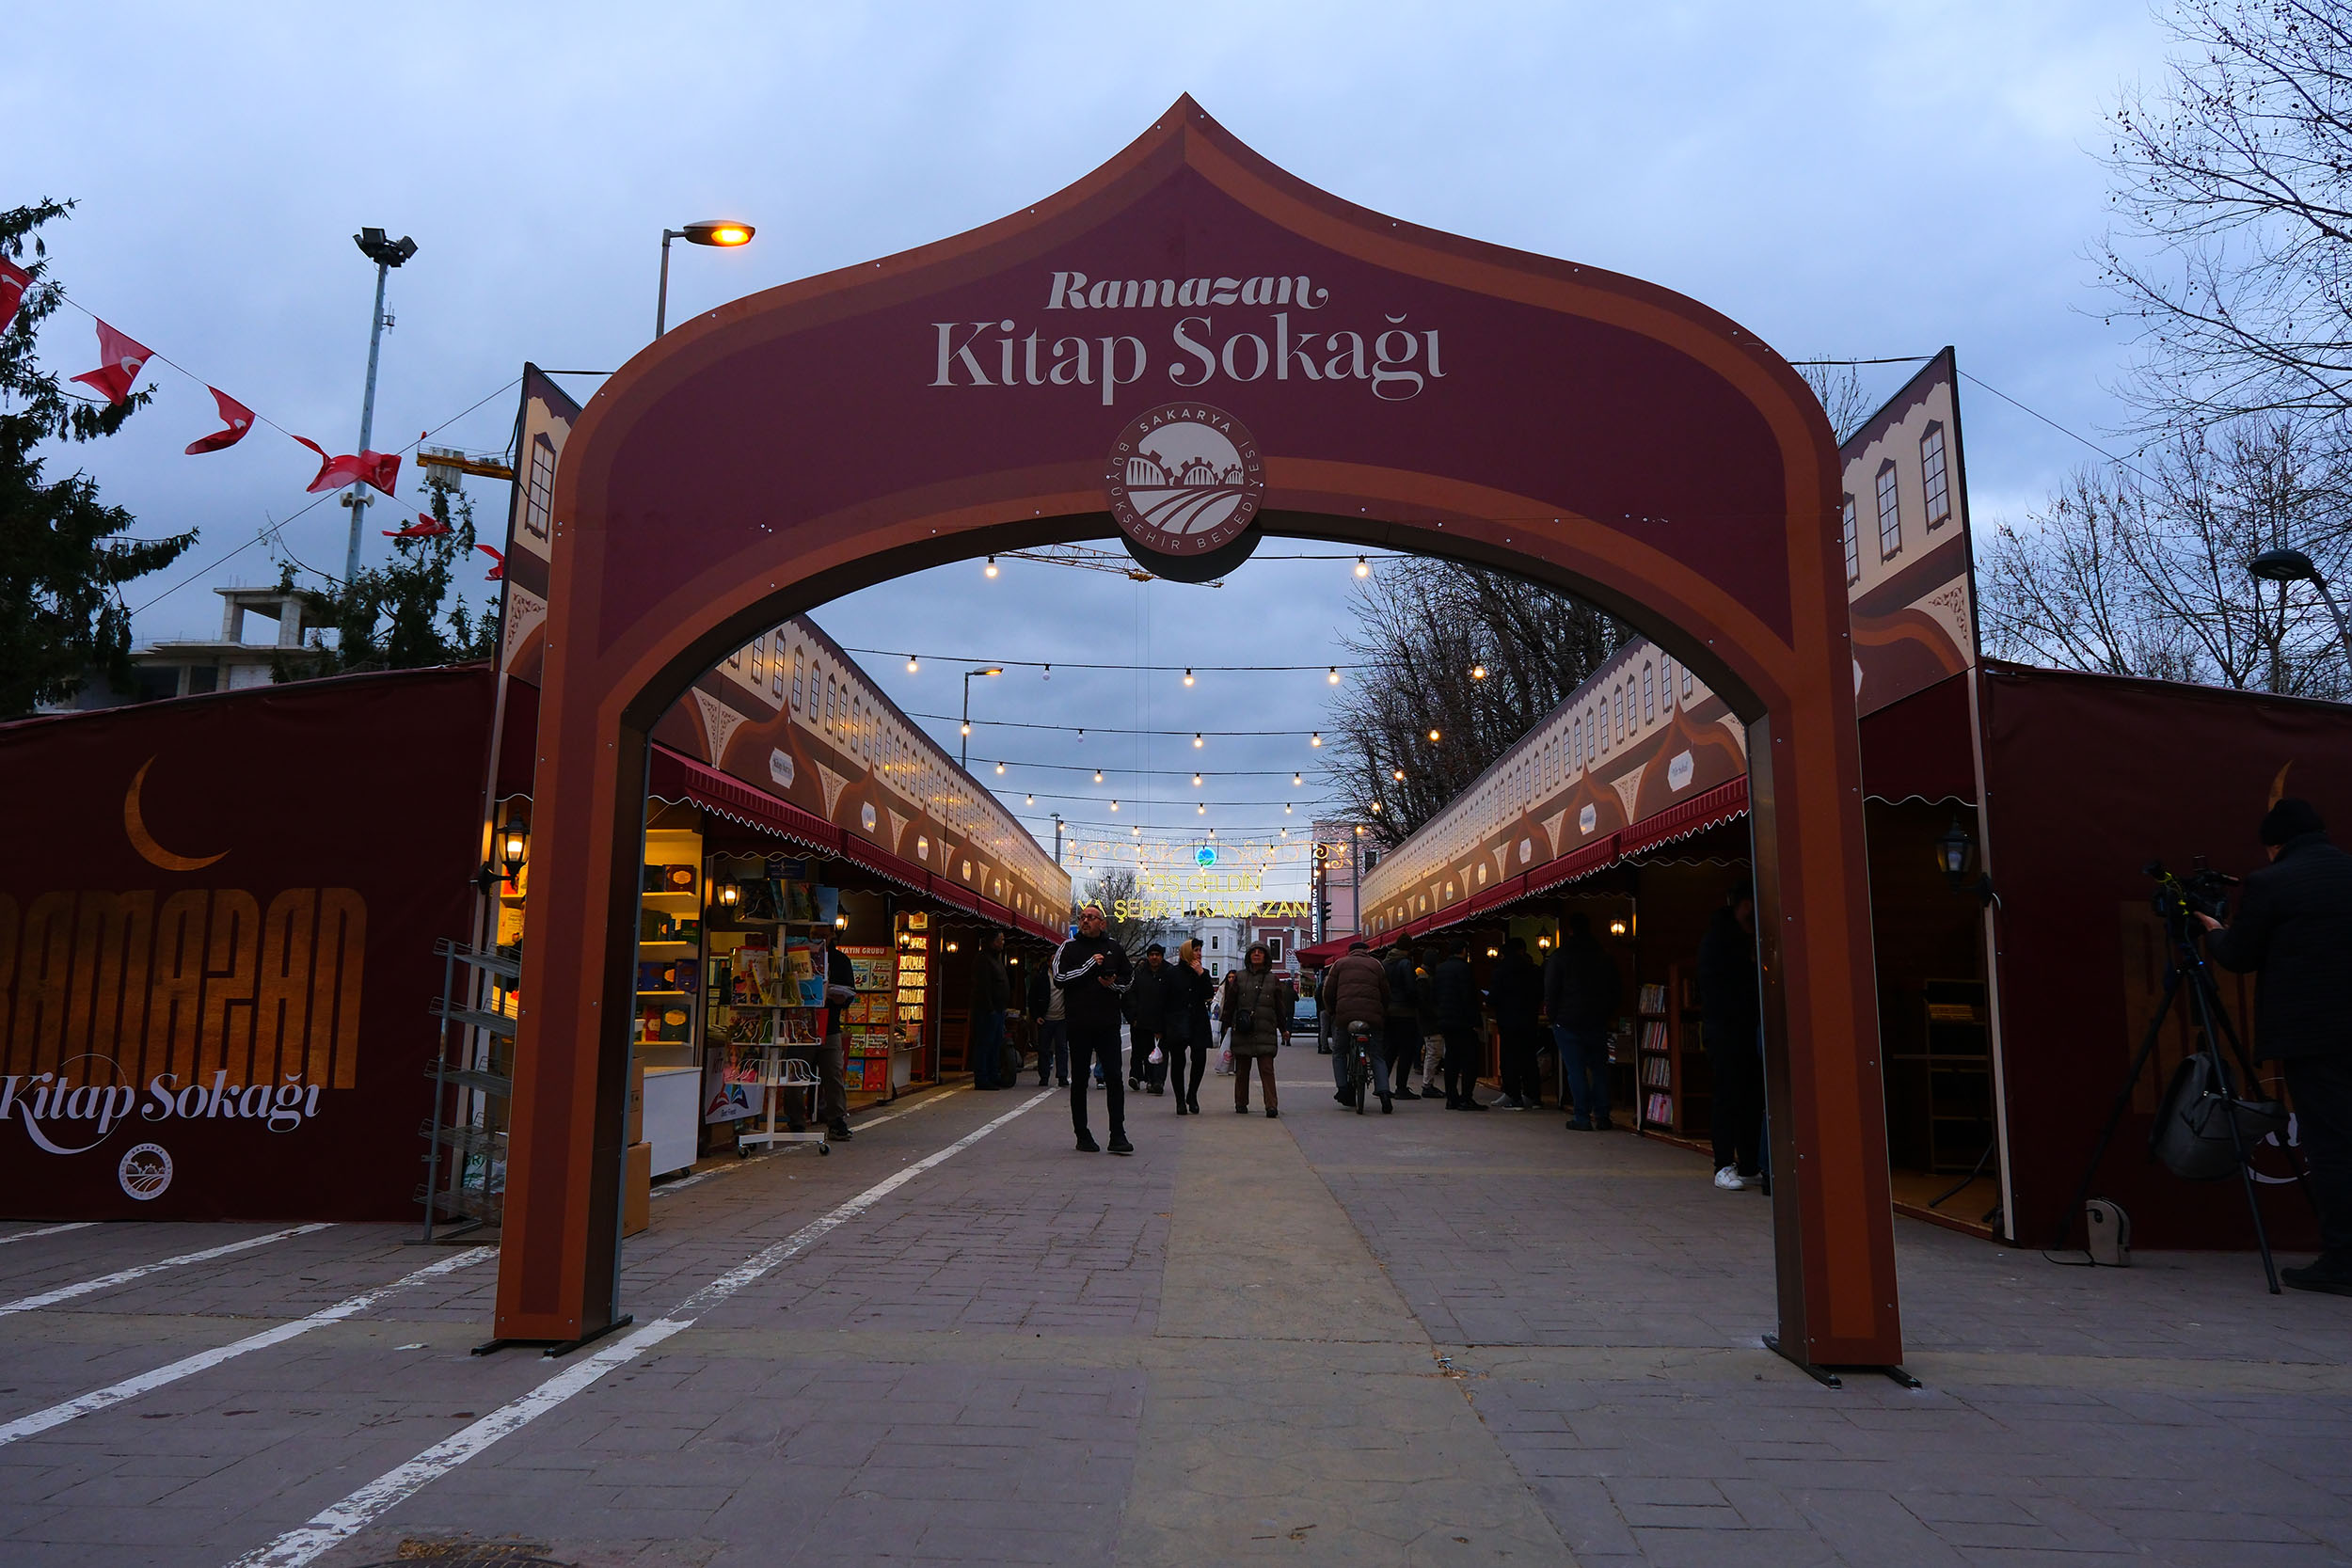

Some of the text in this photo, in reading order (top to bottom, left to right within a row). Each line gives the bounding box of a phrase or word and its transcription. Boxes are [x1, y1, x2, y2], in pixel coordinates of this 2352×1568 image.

[1044, 271, 1329, 310] Ramazan
[928, 312, 1447, 405] Kitap Sokağı
[1139, 408, 1231, 433] SAKARYA
[1136, 871, 1263, 897] HOŞ GELDİN
[1196, 899, 1309, 918] RAMAZAN
[0, 1053, 321, 1155] Kitap Sokağı
